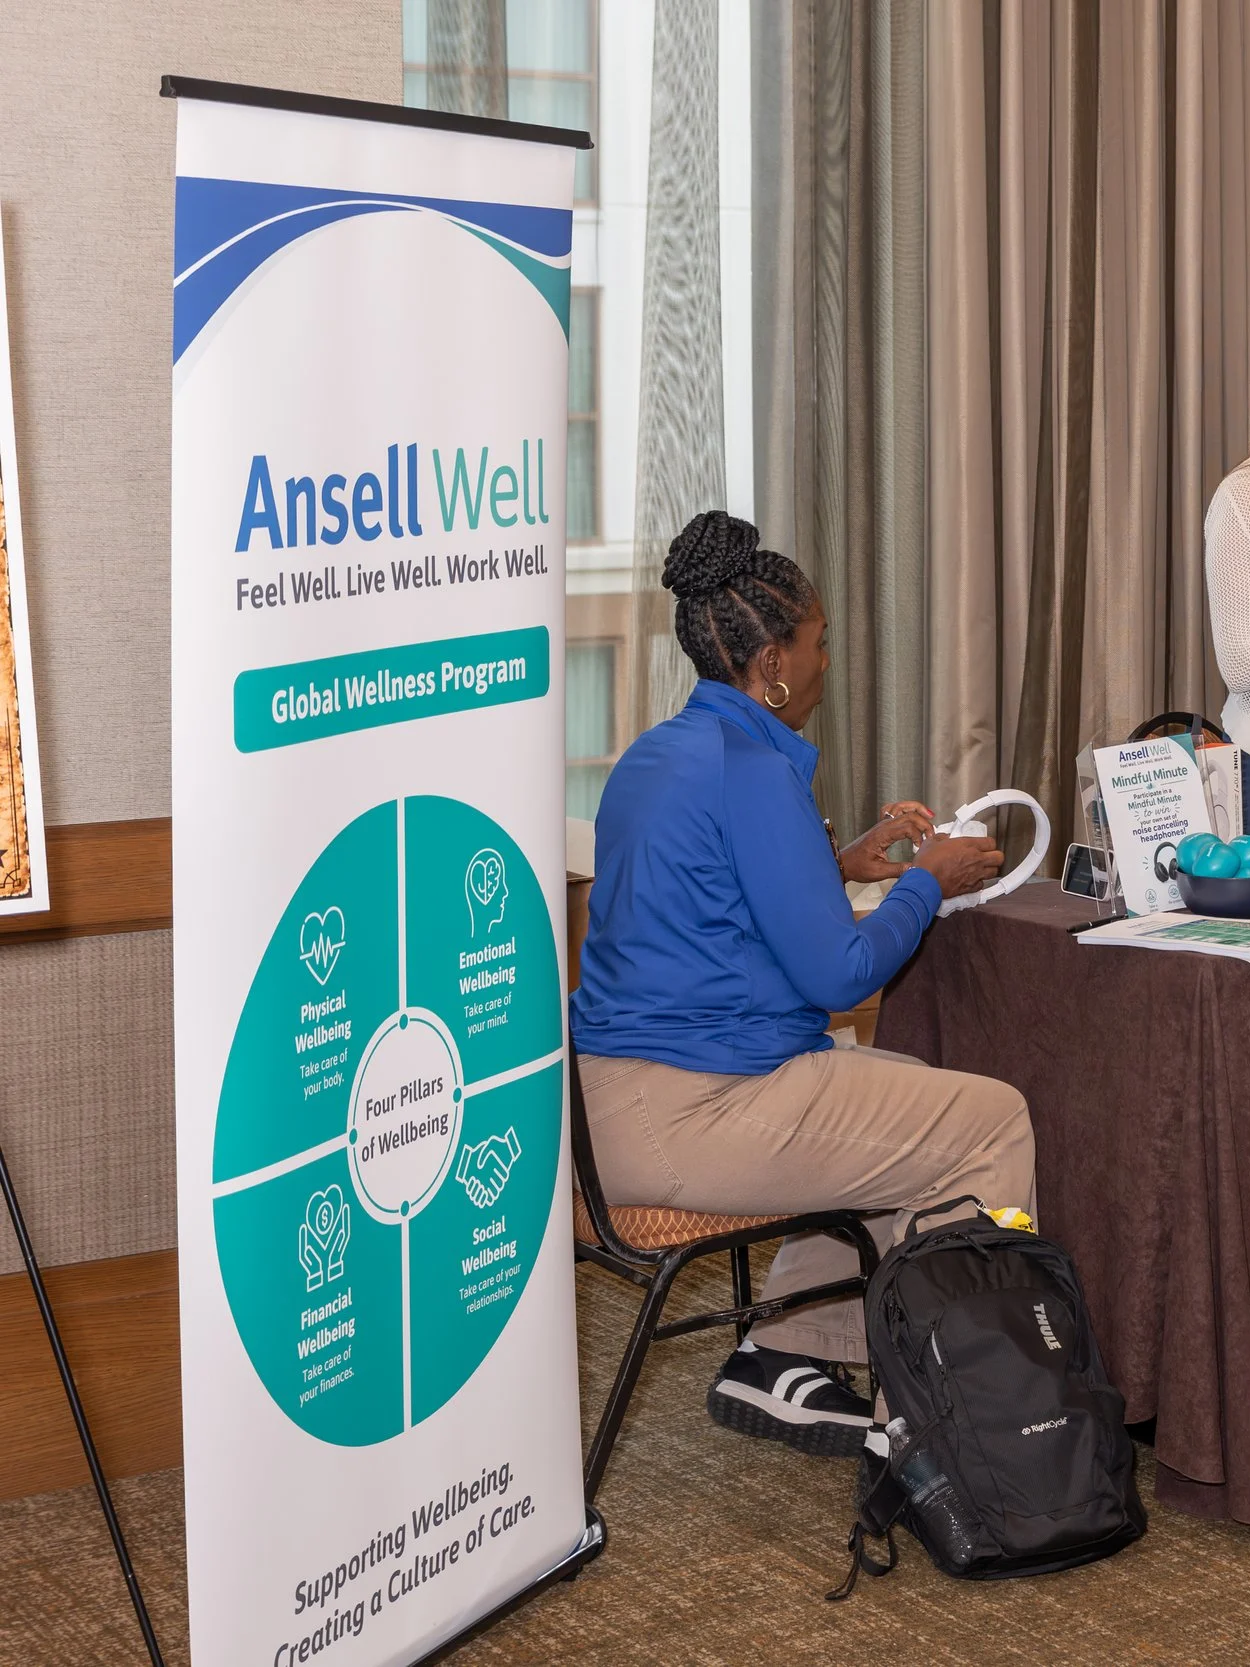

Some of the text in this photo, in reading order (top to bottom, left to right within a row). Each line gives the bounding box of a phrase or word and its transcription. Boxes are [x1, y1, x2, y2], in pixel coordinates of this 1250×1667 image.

[235, 438, 549, 553] Ansell Well
[237, 544, 548, 611] Feel Well. Live Well. Work Well.
[271, 657, 526, 724] Global Wellness Program
[1119, 742, 1171, 762] Ansell Well
[1111, 766, 1188, 788] Mindful Minute
[1128, 794, 1182, 810] Mindful Minute
[1133, 790, 1162, 800] Participate
[1143, 806, 1171, 817] to win
[1132, 819, 1189, 836] noise cancelling
[1140, 819, 1151, 828] your
[1140, 827, 1187, 843] headphones!
[459, 937, 516, 970] Emotional
[459, 965, 516, 995] Wellbeing
[301, 989, 346, 1024] Physical
[464, 992, 512, 1019] Take care of
[295, 1020, 352, 1054] Wellbeing
[468, 1012, 508, 1038] your mind.
[300, 1048, 348, 1079] Take care of
[304, 1071, 345, 1101] your body.
[366, 1076, 443, 1121] Four Pillars
[361, 1113, 449, 1163] of Wellbeing
[473, 1215, 506, 1246] Social
[462, 1239, 517, 1276] Wellbeing
[459, 1264, 521, 1301] Take care of your
[301, 1287, 352, 1330] Financial
[466, 1284, 514, 1315] relationships.
[297, 1317, 355, 1360] Wellbeing
[1033, 1302, 1062, 1351] THULE
[302, 1345, 352, 1383] Take care of
[300, 1366, 355, 1408] your finances.
[294, 1461, 514, 1615] Supporting Wellbeing.
[274, 1495, 535, 1667] Creating a Culture of Care.
